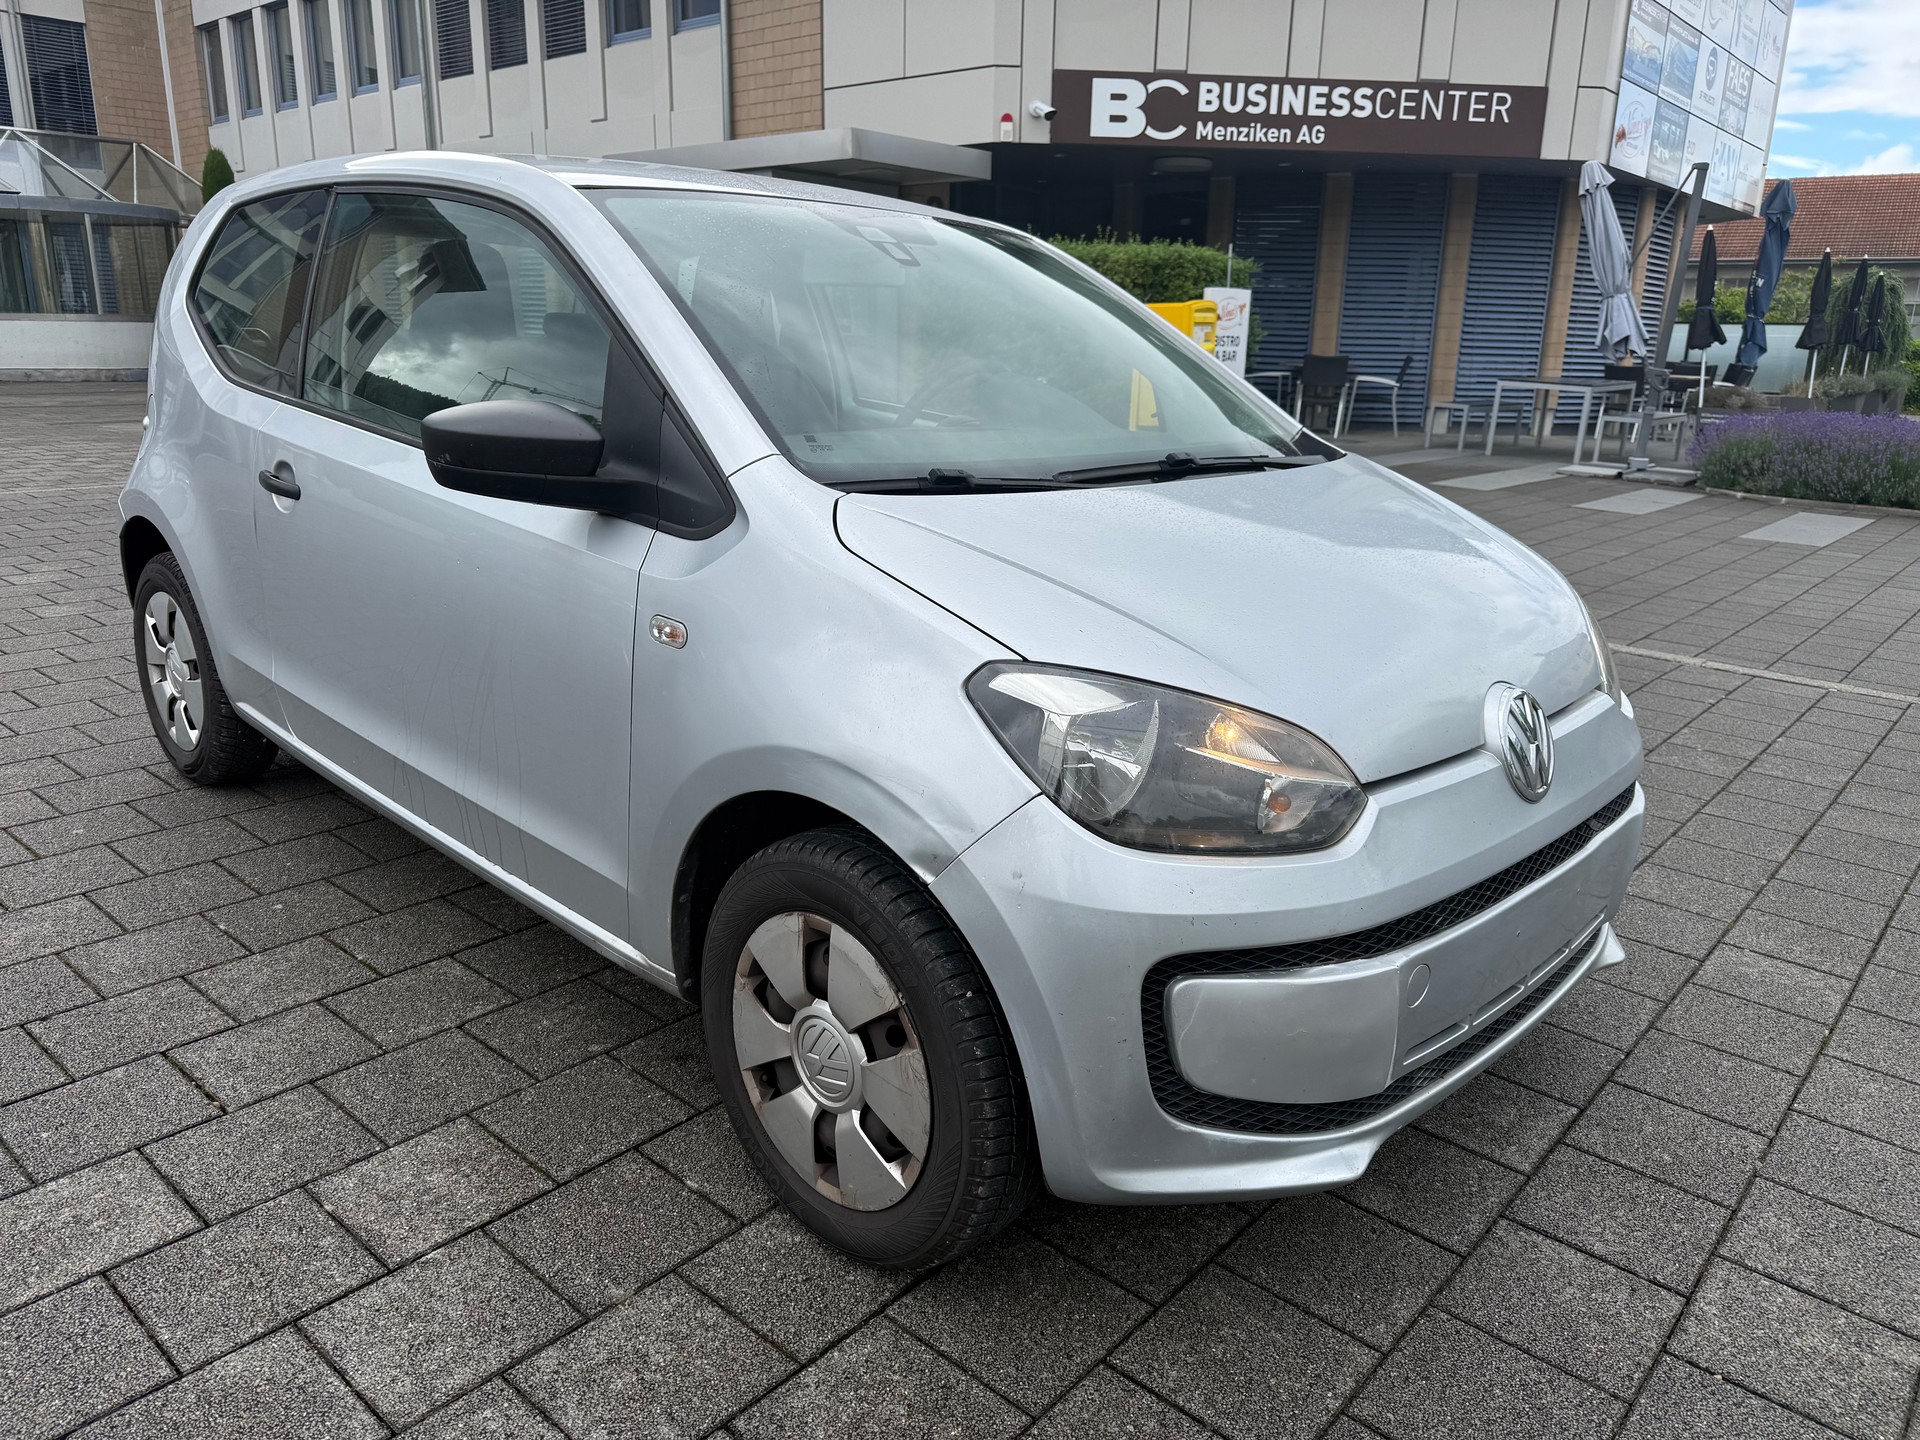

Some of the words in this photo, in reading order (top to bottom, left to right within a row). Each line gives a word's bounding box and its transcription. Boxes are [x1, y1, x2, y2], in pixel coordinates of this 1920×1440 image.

[1089, 77, 1190, 141] BC
[1197, 81, 1512, 123] BUSINESSCENTER
[1196, 121, 1292, 143] Menziken
[1296, 124, 1326, 144] AG
